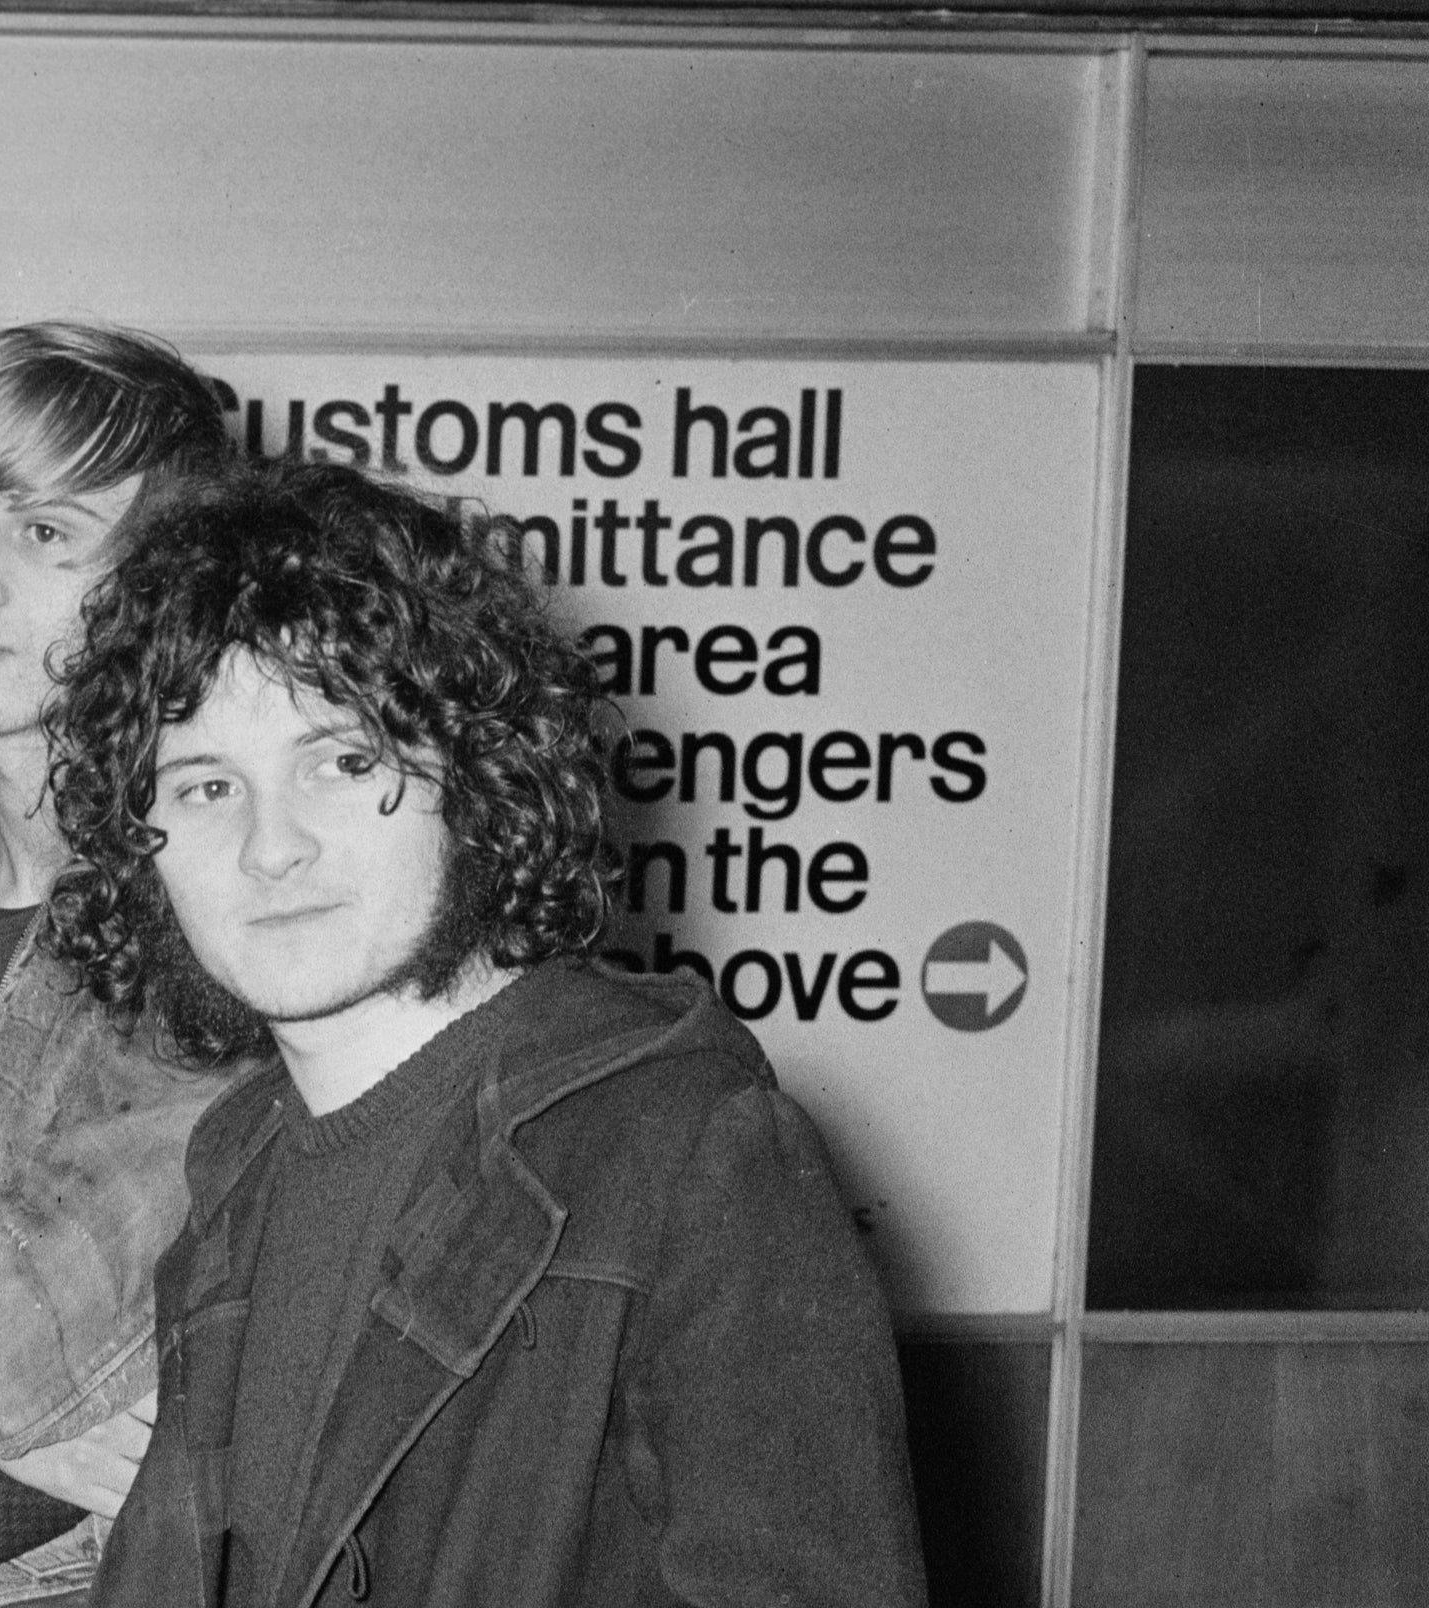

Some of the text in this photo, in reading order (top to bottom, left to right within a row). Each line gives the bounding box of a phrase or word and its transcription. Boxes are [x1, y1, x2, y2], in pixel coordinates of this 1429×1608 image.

[673, 386, 843, 478] hall
[446, 497, 938, 588] mittance
[578, 624, 821, 696] area
[599, 729, 987, 820] engers
[706, 827, 869, 913] the
